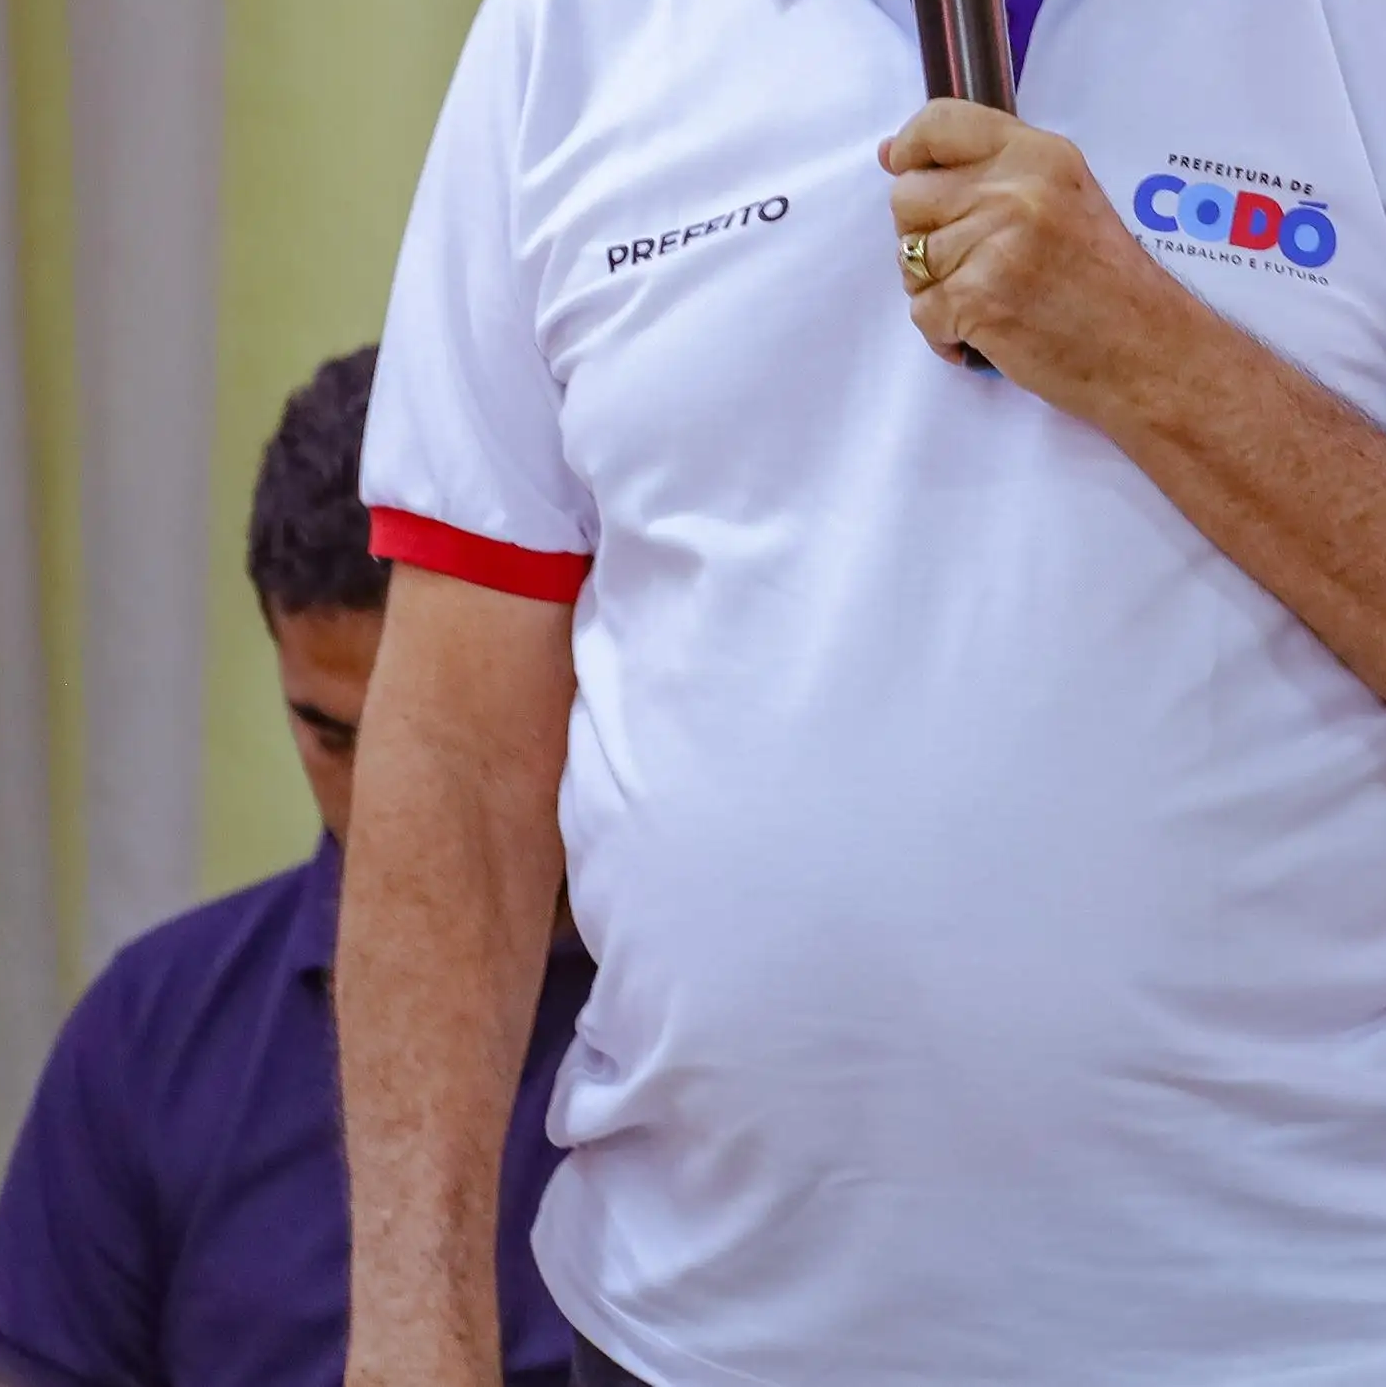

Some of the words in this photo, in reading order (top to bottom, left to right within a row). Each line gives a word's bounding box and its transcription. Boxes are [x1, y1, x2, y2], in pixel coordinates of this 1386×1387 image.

[1168, 153, 1283, 190] PREFEITURA
[1290, 180, 1315, 197] DE
[606, 195, 790, 273] PREFEITO
[1154, 237, 1242, 265] TRABALHO
[1249, 257, 1257, 269] E
[1264, 261, 1329, 286] FUTURO
